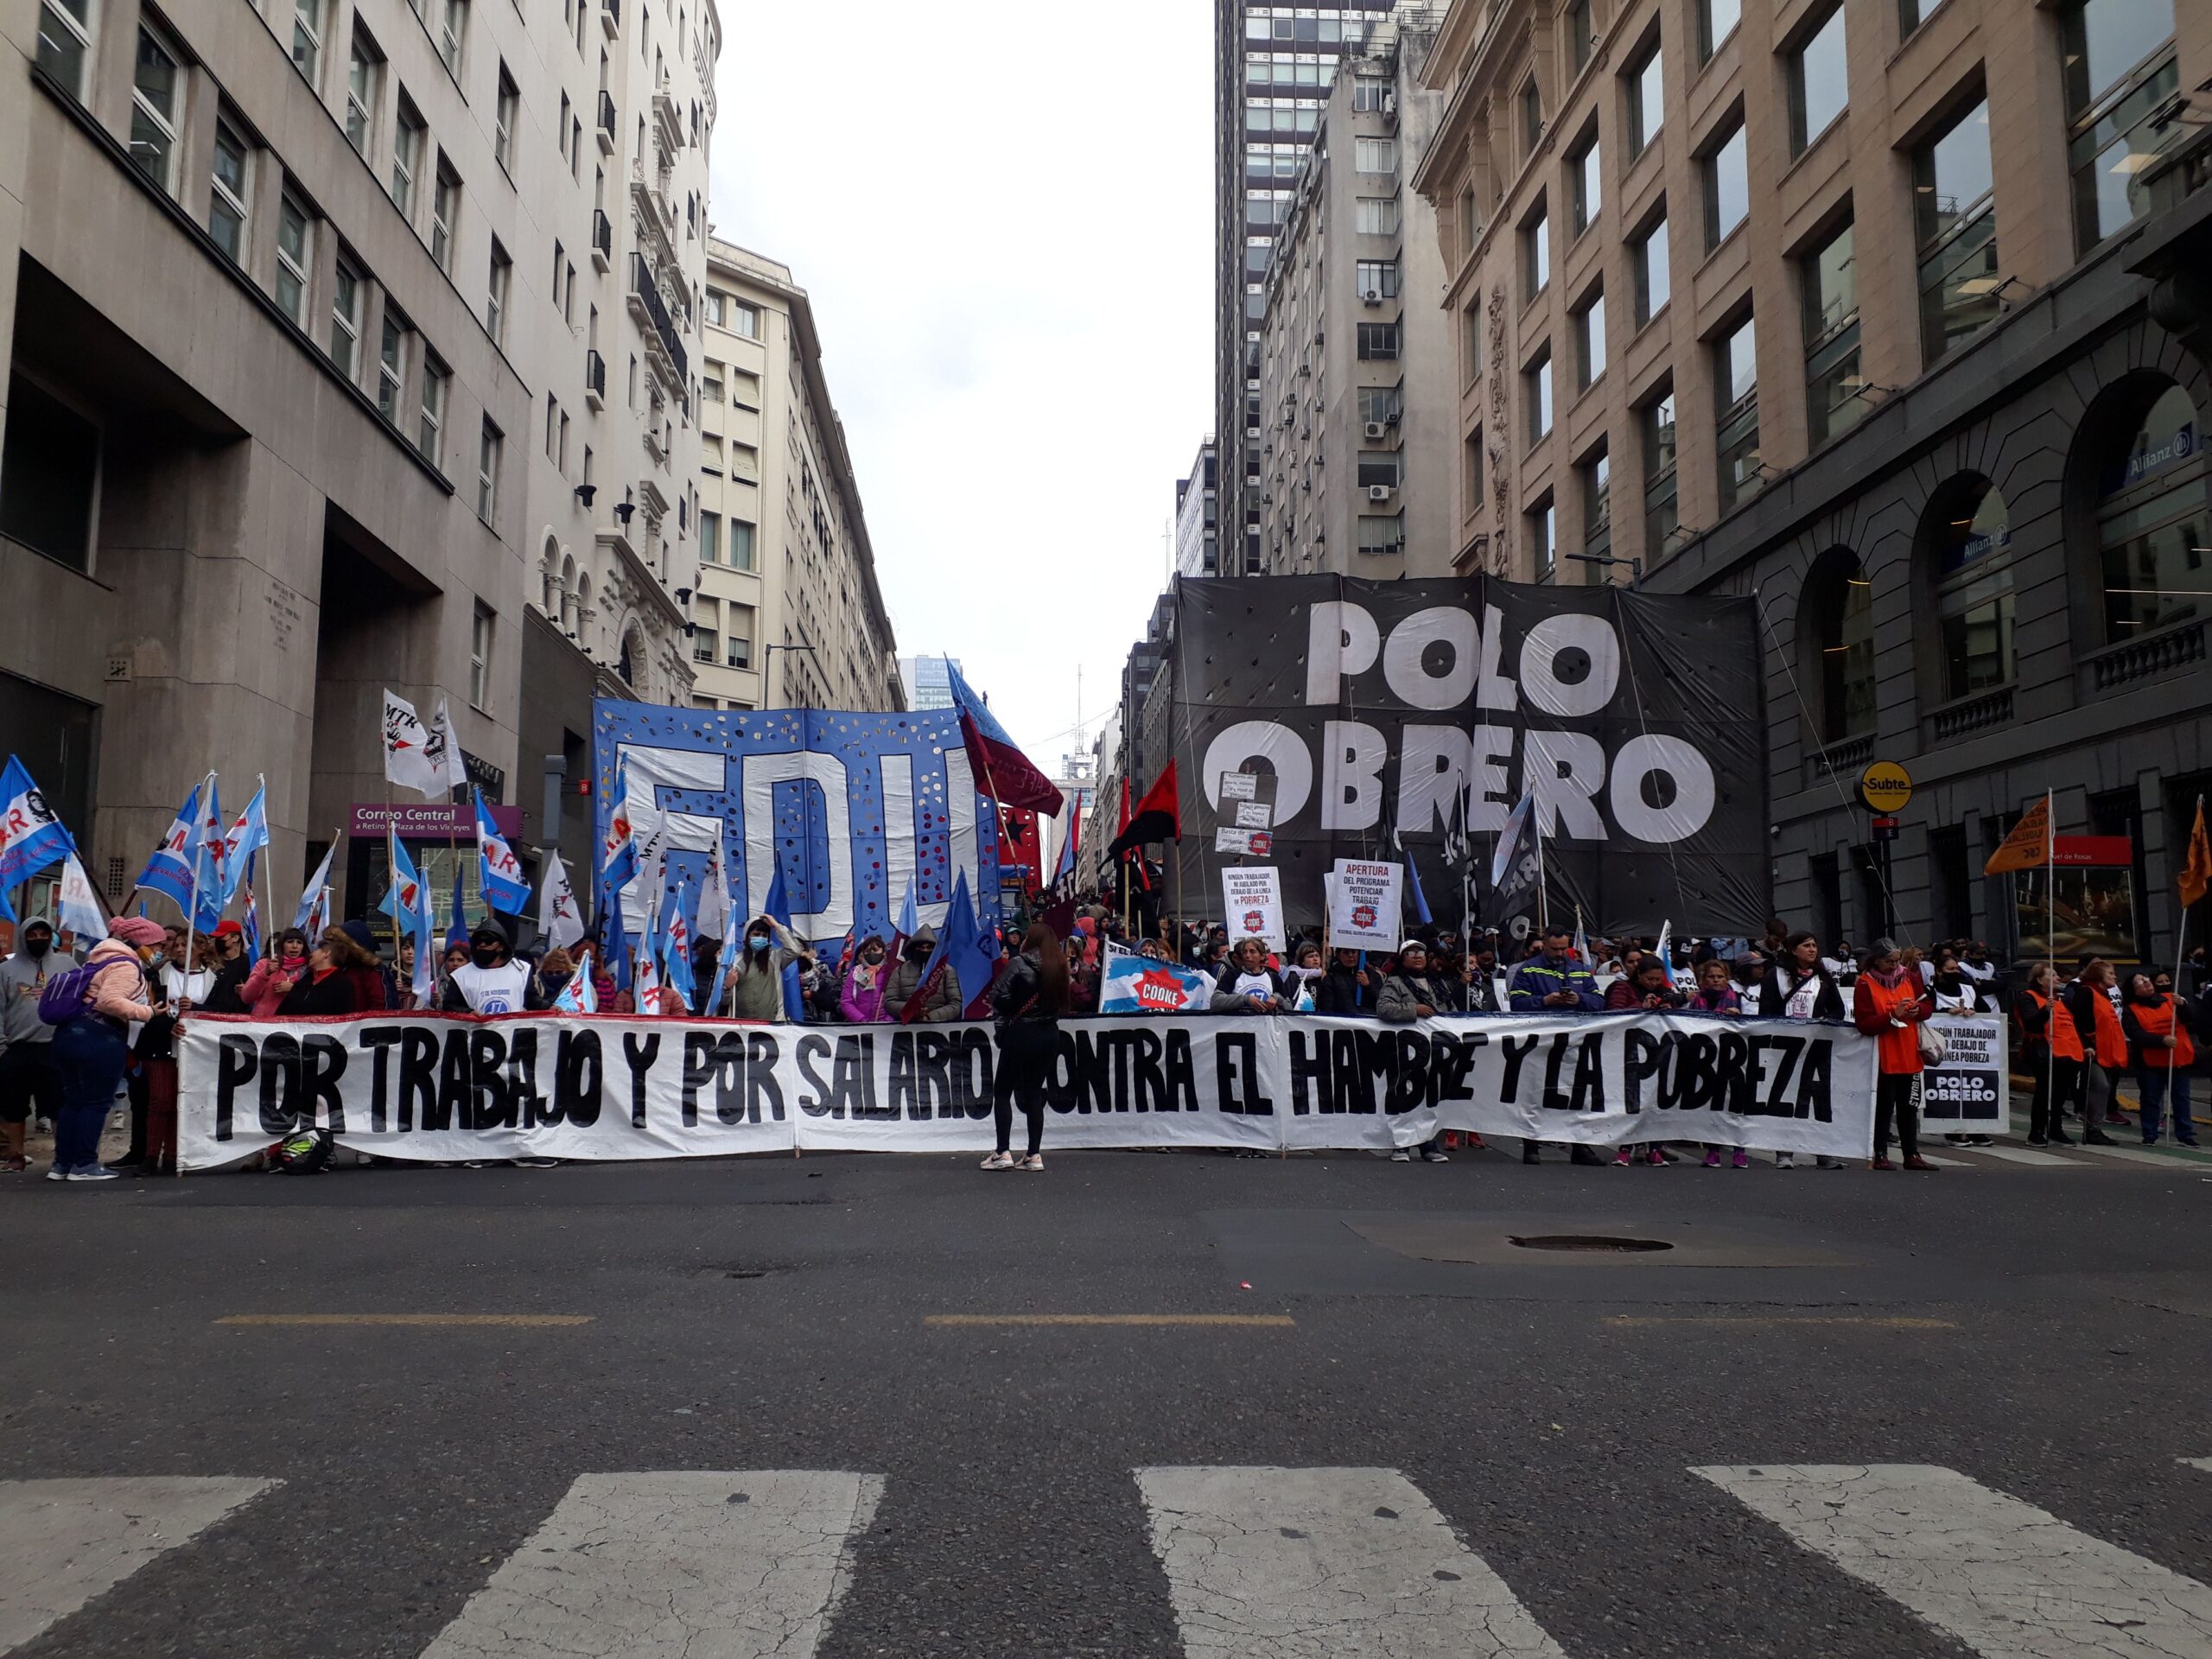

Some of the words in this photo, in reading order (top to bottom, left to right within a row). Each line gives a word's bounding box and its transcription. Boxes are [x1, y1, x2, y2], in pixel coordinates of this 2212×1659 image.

[2131, 446, 2171, 476] Allianz
[1964, 535, 1993, 559] Allianz
[1306, 601, 1620, 716] POLO
[580, 783, 588, 792] B
[1203, 720, 1715, 843] OBRERO
[1869, 778, 1906, 790] Subte
[357, 808, 402, 820] Correo
[406, 809, 455, 821] Central
[1346, 864, 1389, 876] APERTURA
[1344, 876, 1355, 885] DEL
[1356, 877, 1389, 887] PROGRAMA
[1350, 887, 1383, 895] POTENCIAR
[1240, 895, 1269, 905] POBREZA
[1352, 896, 1379, 906] TRABAJO
[1143, 984, 1178, 1006] COOKE
[492, 1001, 502, 1012] 17
[1954, 1028, 1996, 1039] TRABAJADOR
[1952, 1040, 1976, 1051] DEBAJO
[1979, 1041, 1986, 1051] DE
[1961, 1053, 1989, 1063] POBREZA
[216, 1032, 347, 1141] POR
[359, 1027, 603, 1132] TRABAJO
[623, 1033, 660, 1128] Y
[682, 1031, 785, 1128] POR
[796, 1027, 995, 1121] SALARIO
[1216, 1032, 1273, 1116] EL
[1287, 1029, 1489, 1116] HAMBRE
[1500, 1033, 1540, 1103] Y
[1542, 1032, 1605, 1113] LA
[1624, 1027, 1833, 1123] POBREZA
[1936, 1077, 1984, 1089] POLO
[1925, 1089, 1996, 1102] OBRERO
